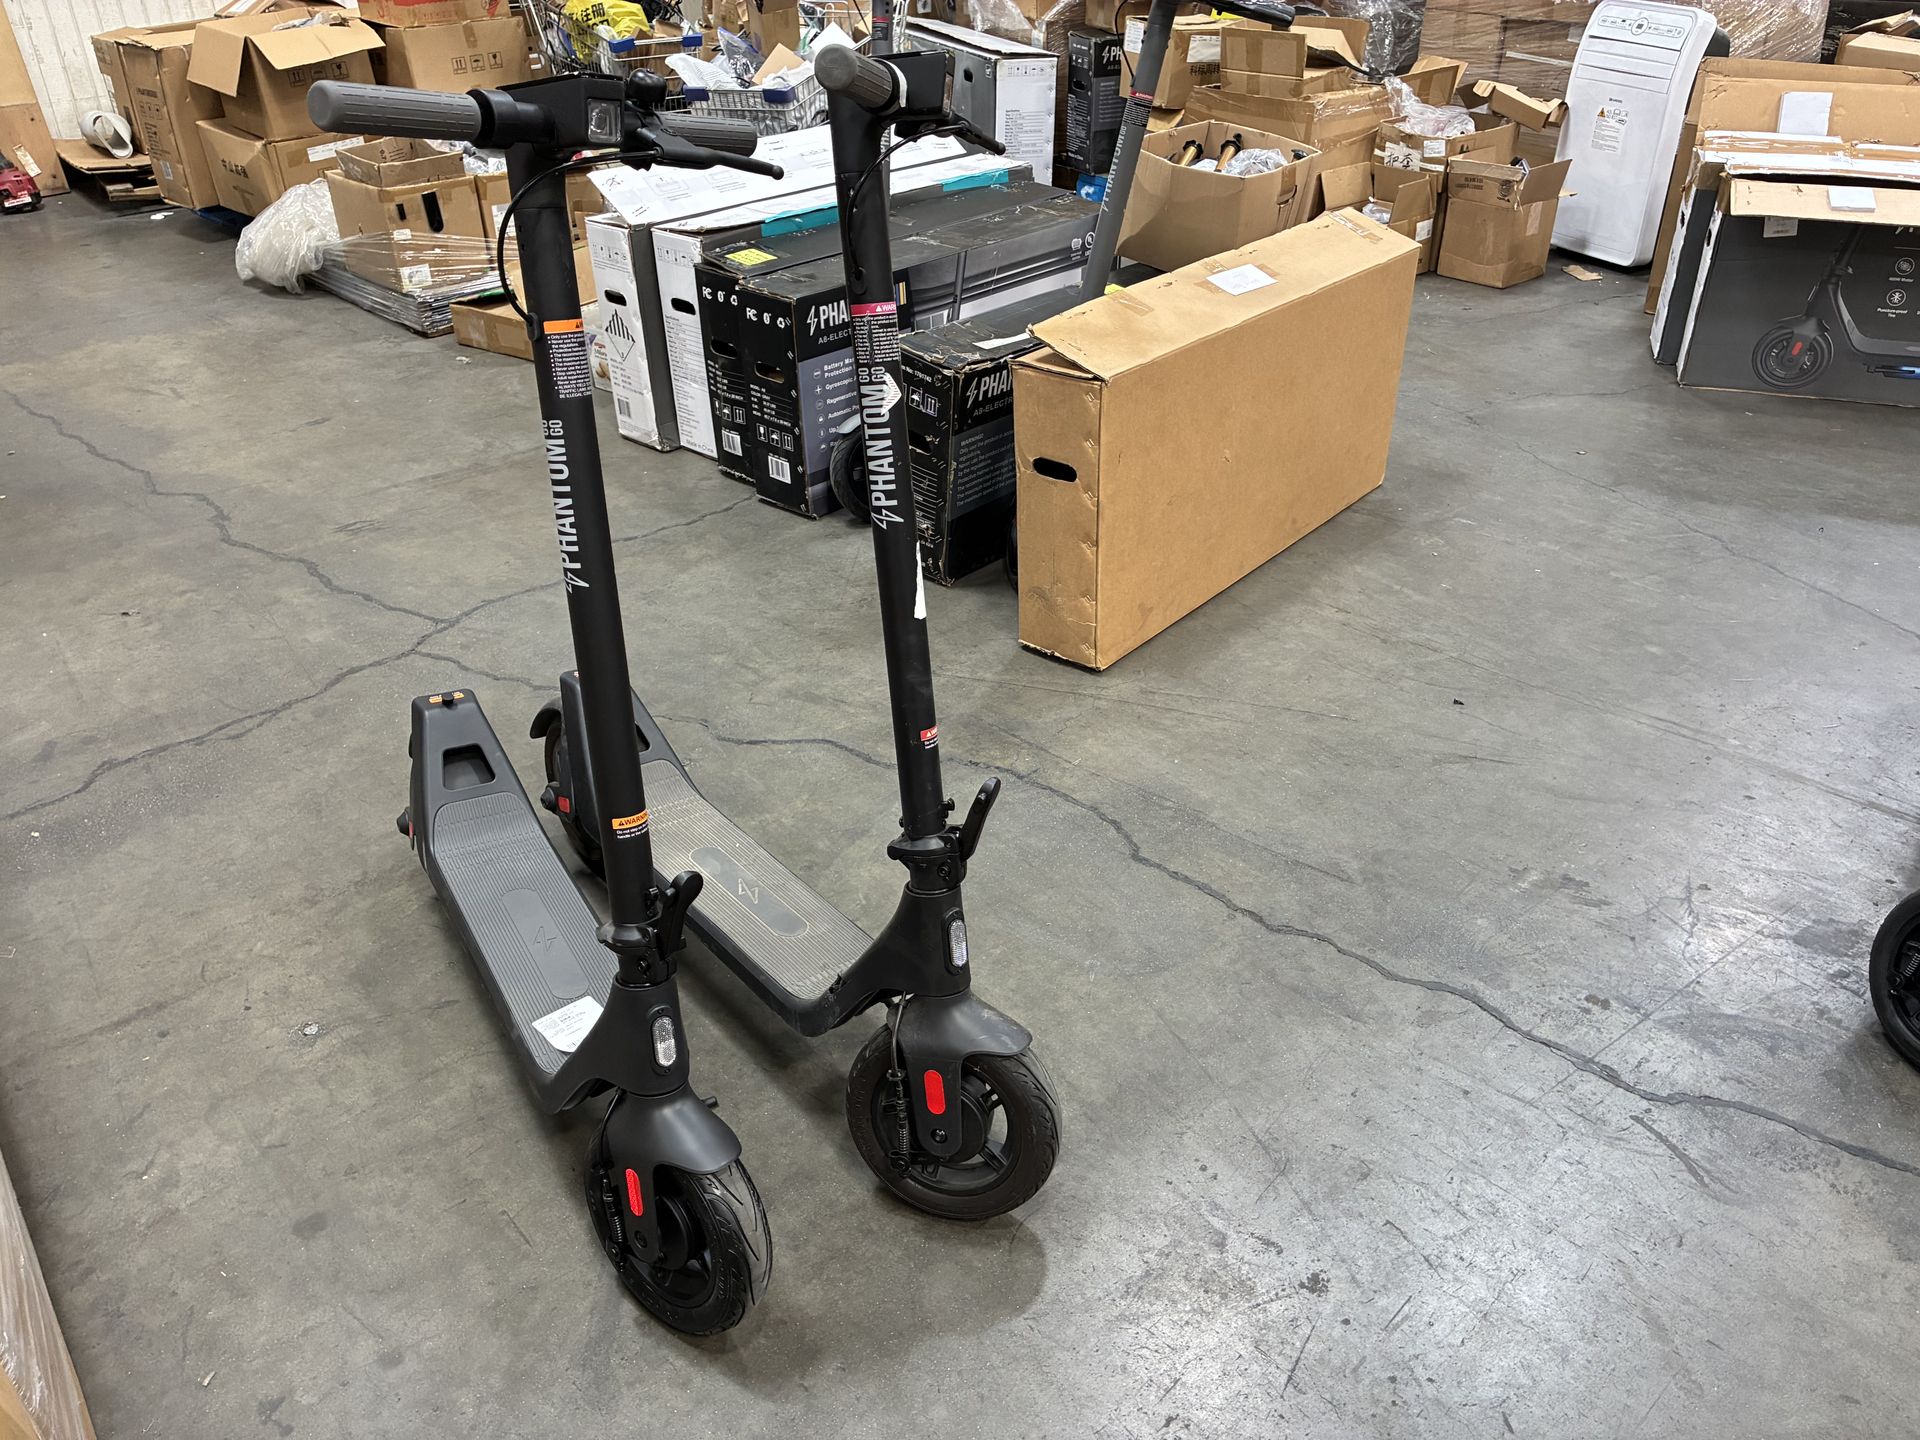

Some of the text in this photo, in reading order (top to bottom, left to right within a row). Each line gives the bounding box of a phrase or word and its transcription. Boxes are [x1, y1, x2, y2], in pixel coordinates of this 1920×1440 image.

[550, 420, 563, 435] GO
[860, 384, 898, 506] PHANTOM
[546, 438, 581, 569] PHANTOM
